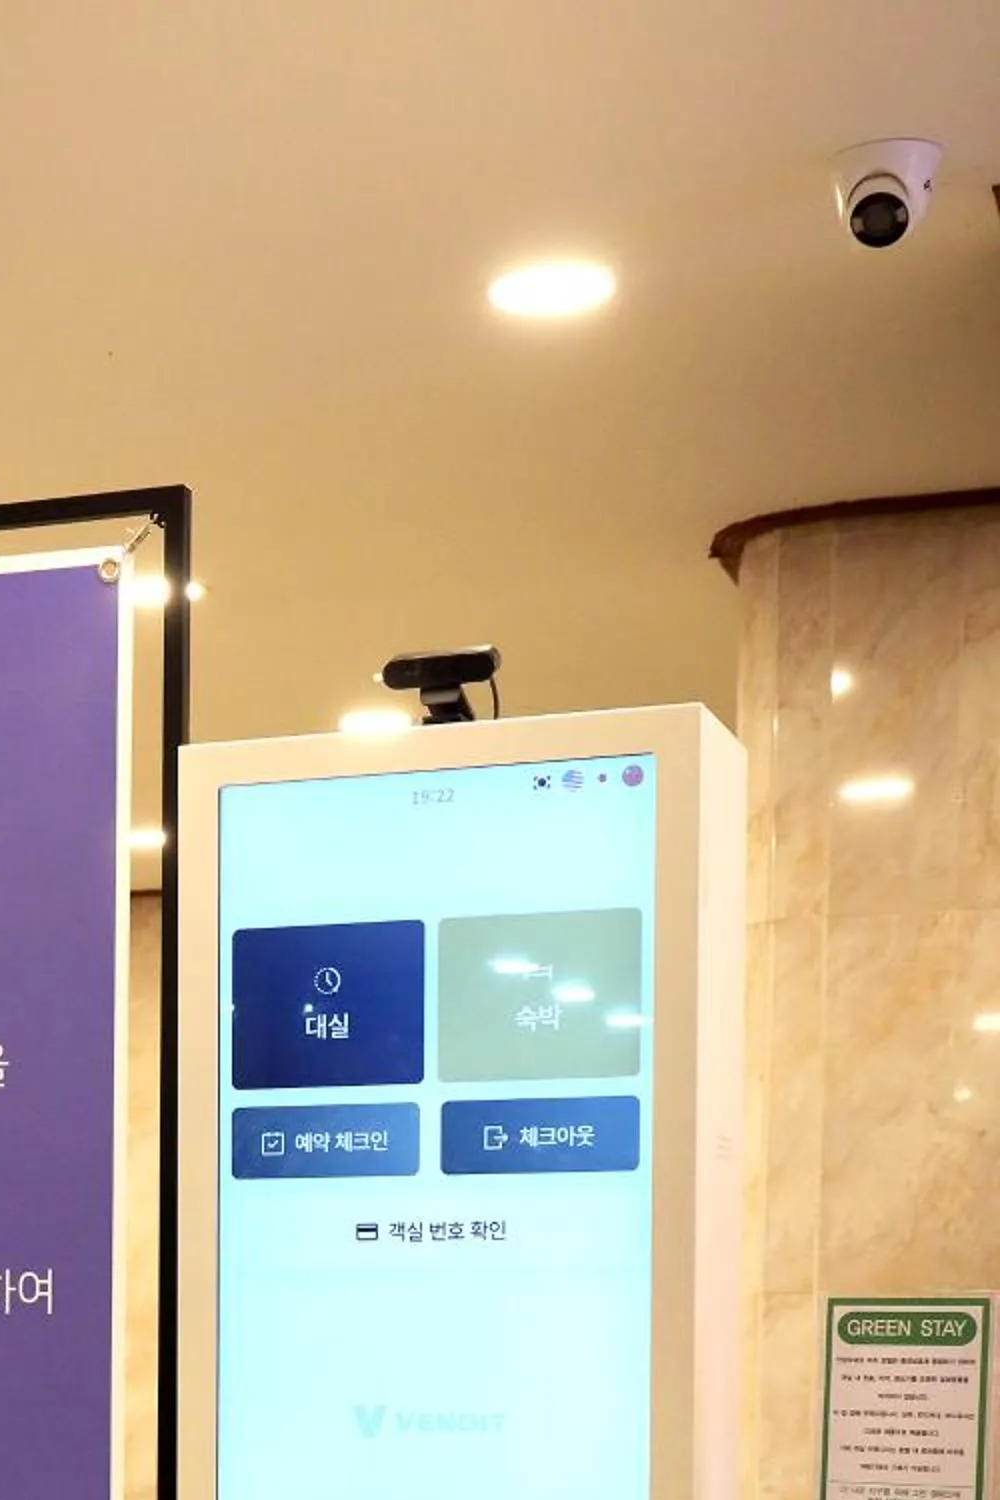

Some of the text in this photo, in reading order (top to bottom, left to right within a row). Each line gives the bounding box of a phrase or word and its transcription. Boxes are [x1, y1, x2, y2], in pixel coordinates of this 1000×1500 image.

[305, 1013, 350, 1040] 대실
[514, 1004, 563, 1031] 숙박
[295, 1130, 388, 1153] 예약 체크인
[519, 1125, 596, 1148] 체크아웃
[388, 1220, 508, 1242] 객실 번호 확인
[847, 1319, 967, 1338] GREEN STAY
[395, 1412, 507, 1433] VENDIT
